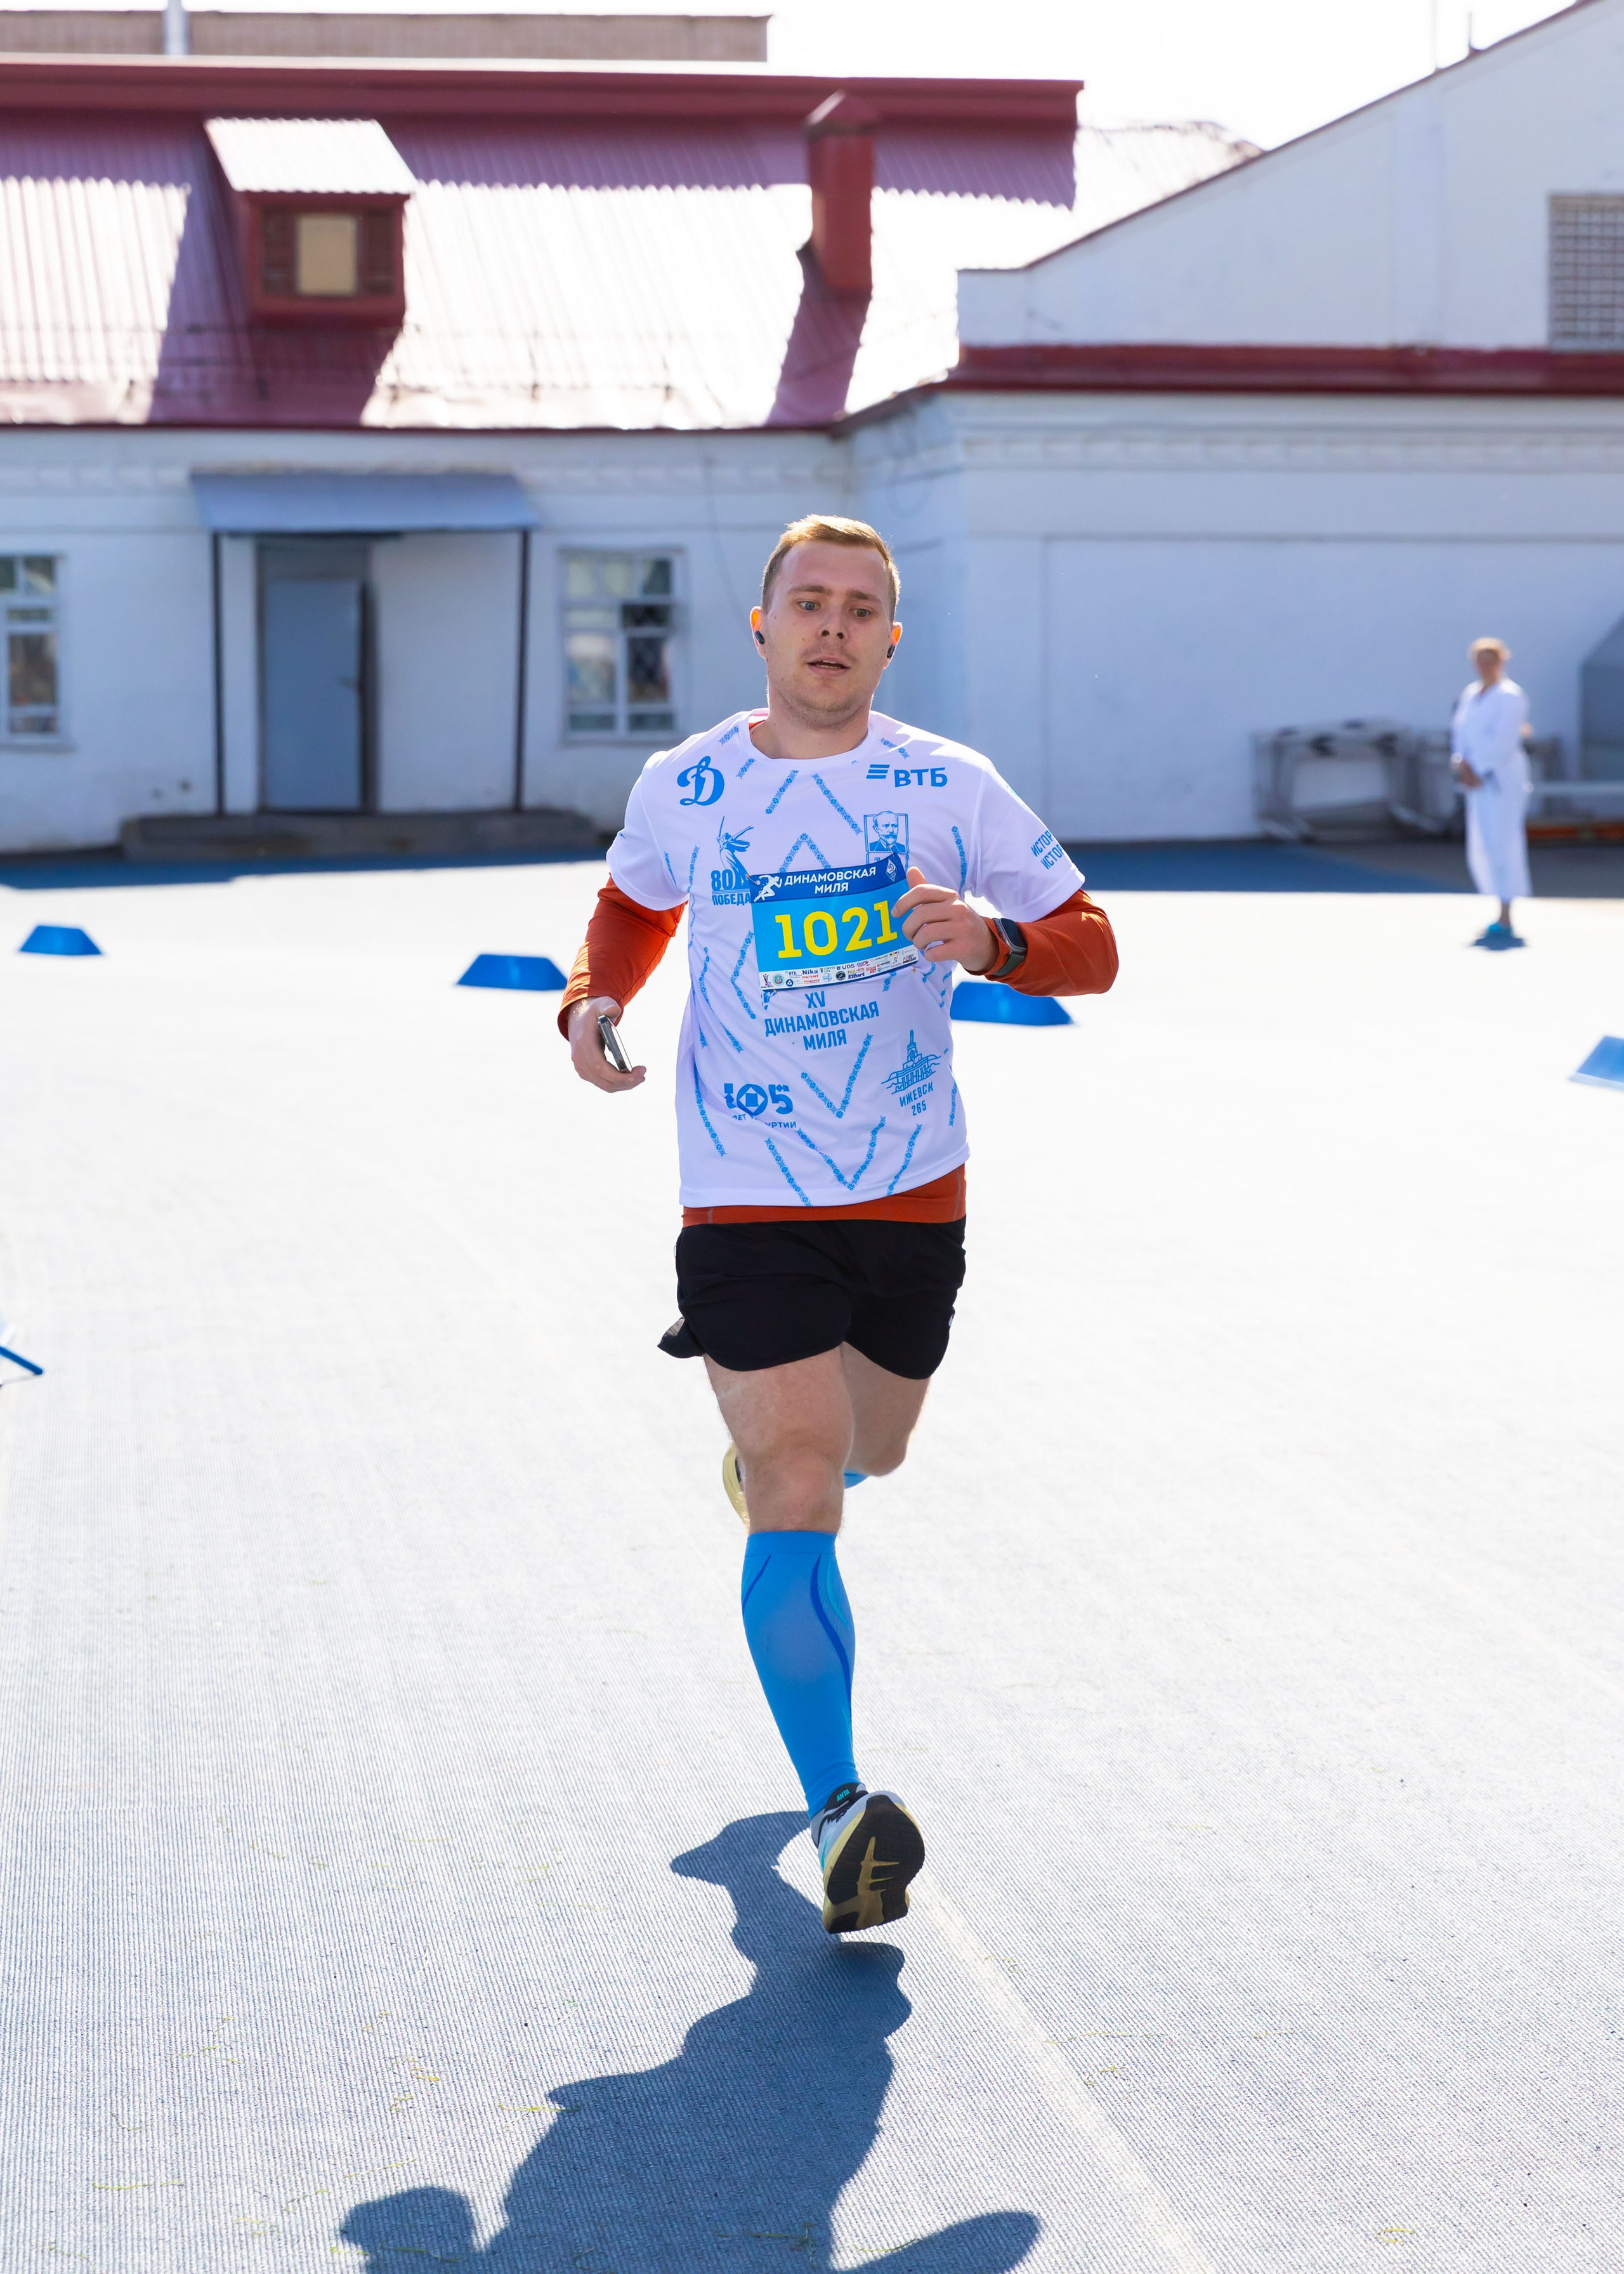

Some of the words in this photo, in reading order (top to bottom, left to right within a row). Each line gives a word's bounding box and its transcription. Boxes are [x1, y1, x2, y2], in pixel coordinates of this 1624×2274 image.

[894, 767, 948, 787] ВТБ
[710, 869, 733, 891] 80
[784, 866, 876, 886] ДИНАМОВСКАЯ
[815, 882, 849, 894] МИЛЯ
[712, 893, 751, 905] ПОБЕДА
[775, 900, 898, 958] 1021
[804, 990, 826, 1008] XV
[764, 1001, 879, 1037] ДИНАМОВСКАЯ
[802, 1029, 847, 1050] МИЛЯ
[899, 1081, 934, 1107] ИЖЕВСК
[912, 1100, 926, 1116] 265
[837, 1789, 850, 1802] ANTA
